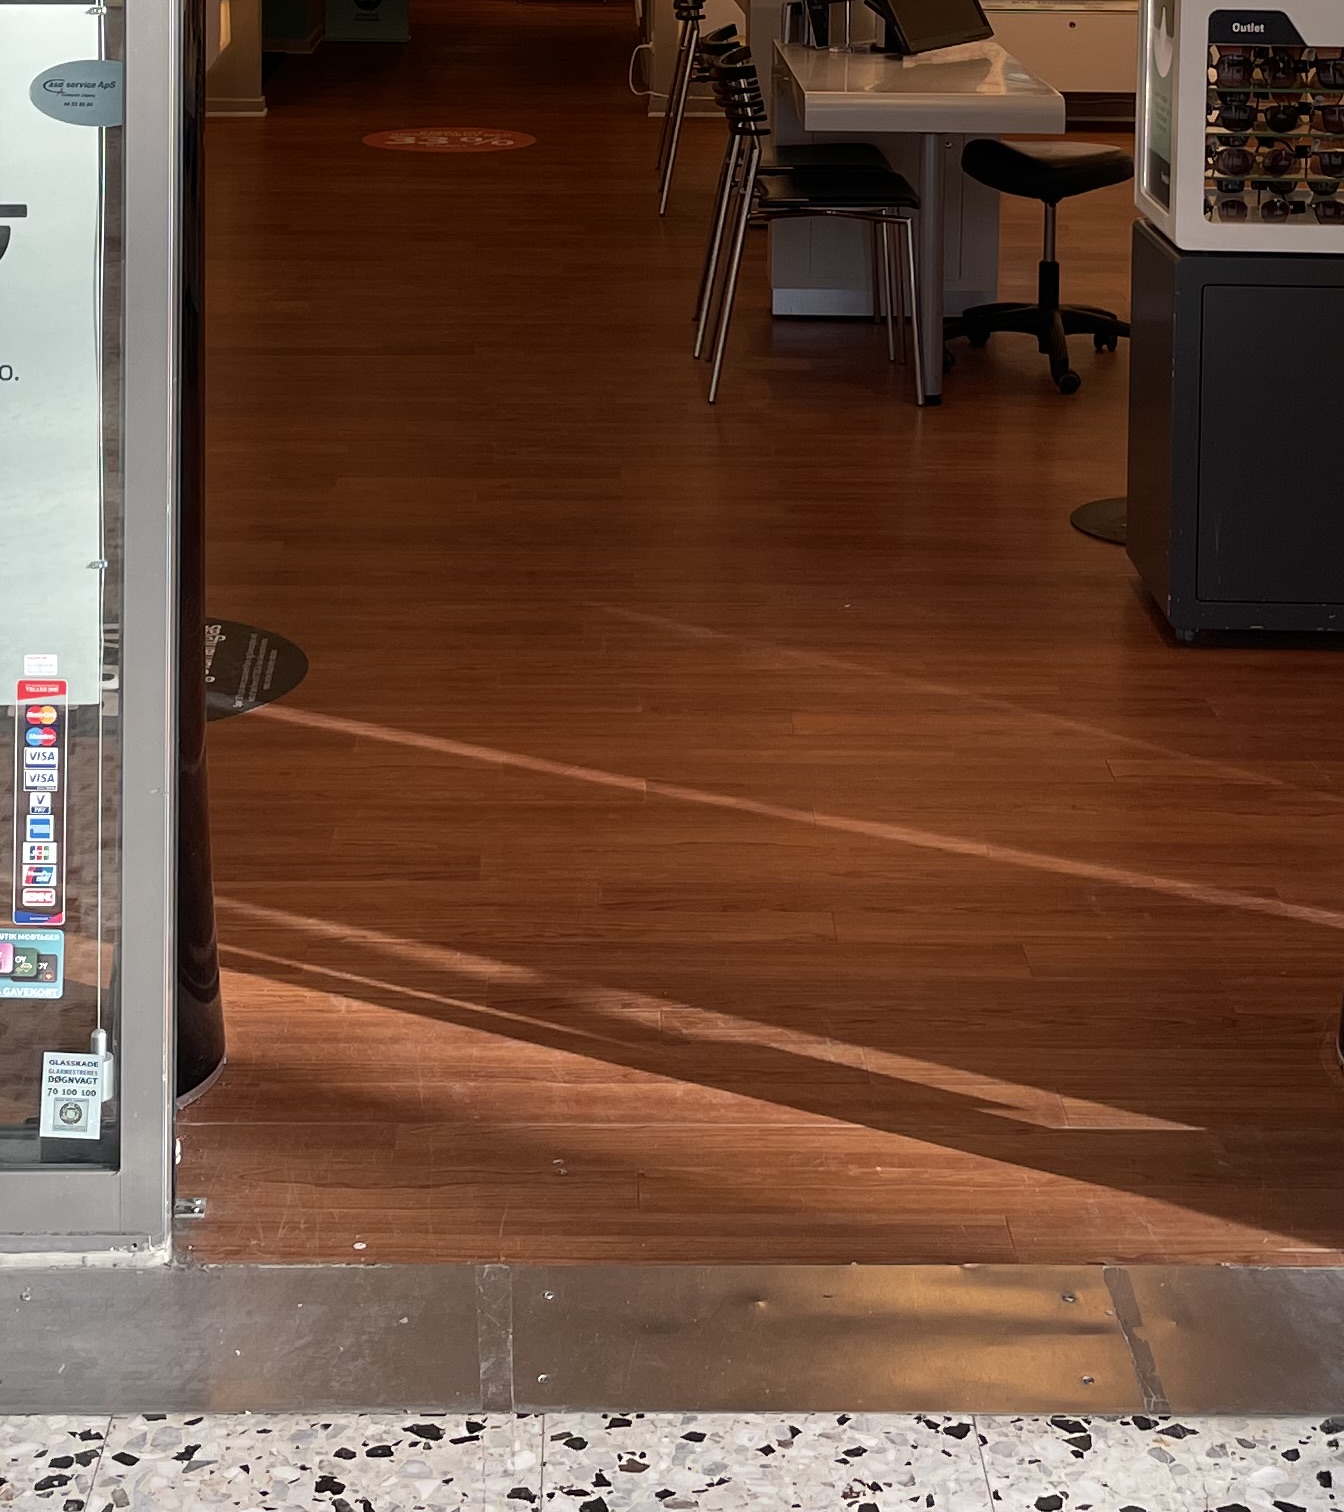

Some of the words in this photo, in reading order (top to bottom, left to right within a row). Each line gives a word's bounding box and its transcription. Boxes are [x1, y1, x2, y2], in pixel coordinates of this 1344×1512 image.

[1232, 22, 1265, 33] Outlet
[98, 81, 116, 90] ApS
[30, 751, 54, 761] VISA
[29, 773, 54, 783] VISA
[49, 1059, 98, 1068] GLASSKADE
[47, 1075, 98, 1085] DØGNVAGT
[47, 1088, 58, 1097] 70
[62, 1088, 77, 1096] 100
